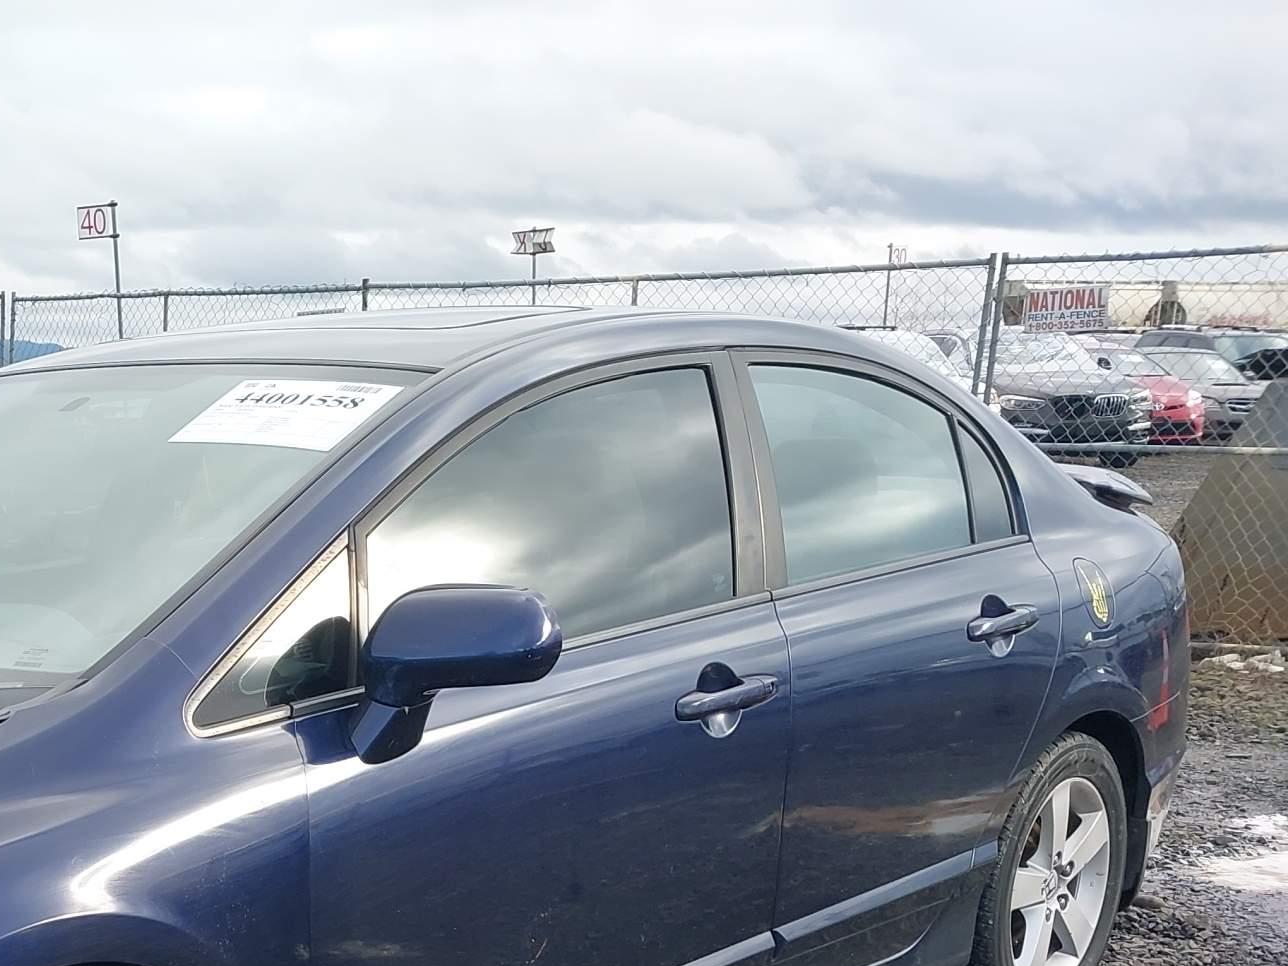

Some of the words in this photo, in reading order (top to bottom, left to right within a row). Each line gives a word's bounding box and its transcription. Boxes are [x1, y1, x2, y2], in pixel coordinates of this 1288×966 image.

[81, 208, 106, 235] 40
[1028, 288, 1106, 312] NATIONAL
[1027, 309, 1106, 322] RENT-A-FENCE
[235, 392, 365, 409] 44001558
